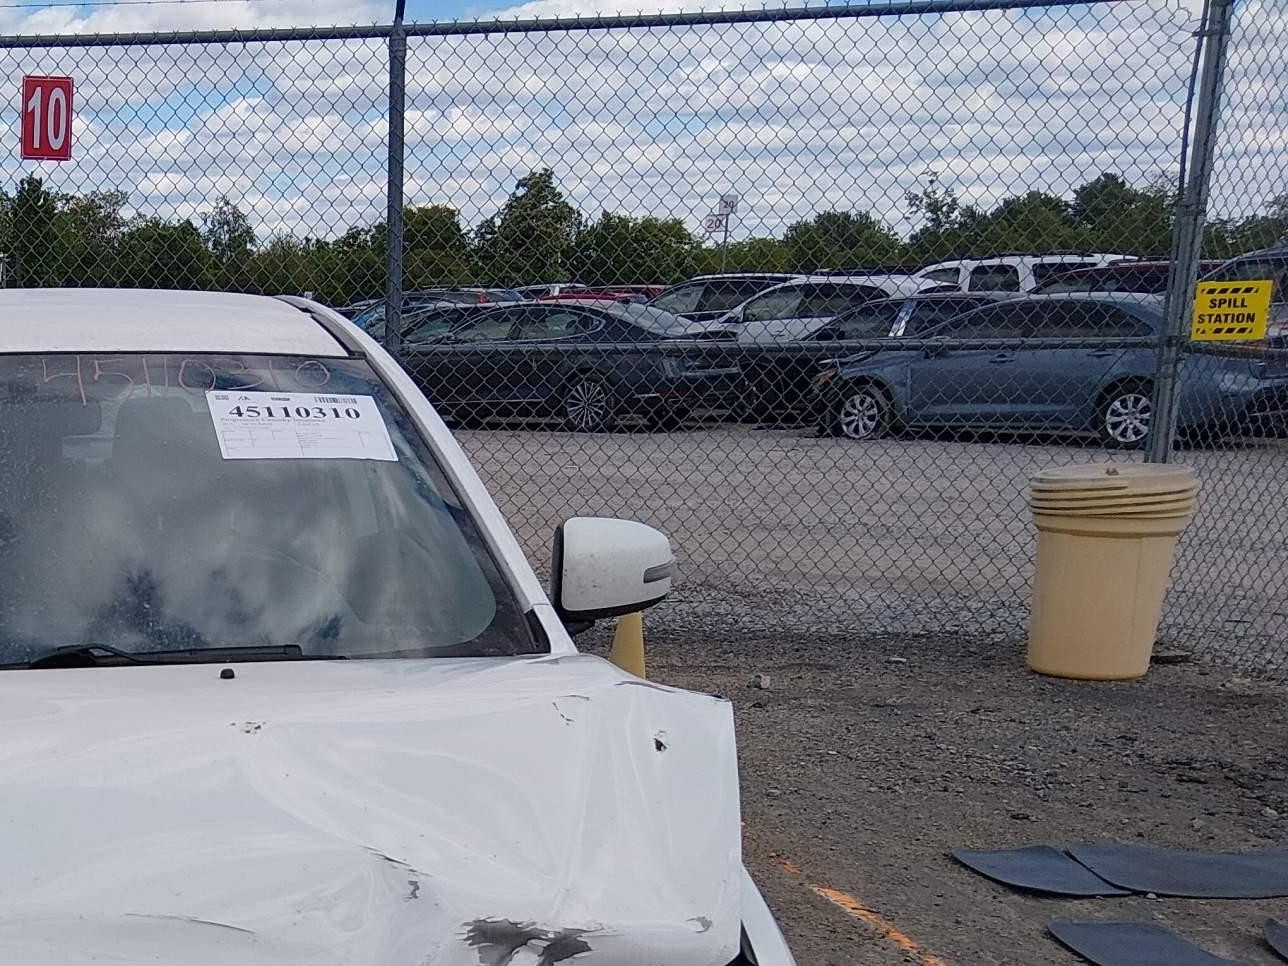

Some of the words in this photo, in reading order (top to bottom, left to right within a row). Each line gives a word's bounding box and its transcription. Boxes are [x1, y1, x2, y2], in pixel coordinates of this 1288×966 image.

[27, 86, 67, 151] 10
[707, 218, 721, 229] 20
[1208, 297, 1248, 309] SPILL
[1197, 312, 1256, 324] STATION
[41, 354, 330, 407] 45110310
[228, 405, 361, 420] 45110310
